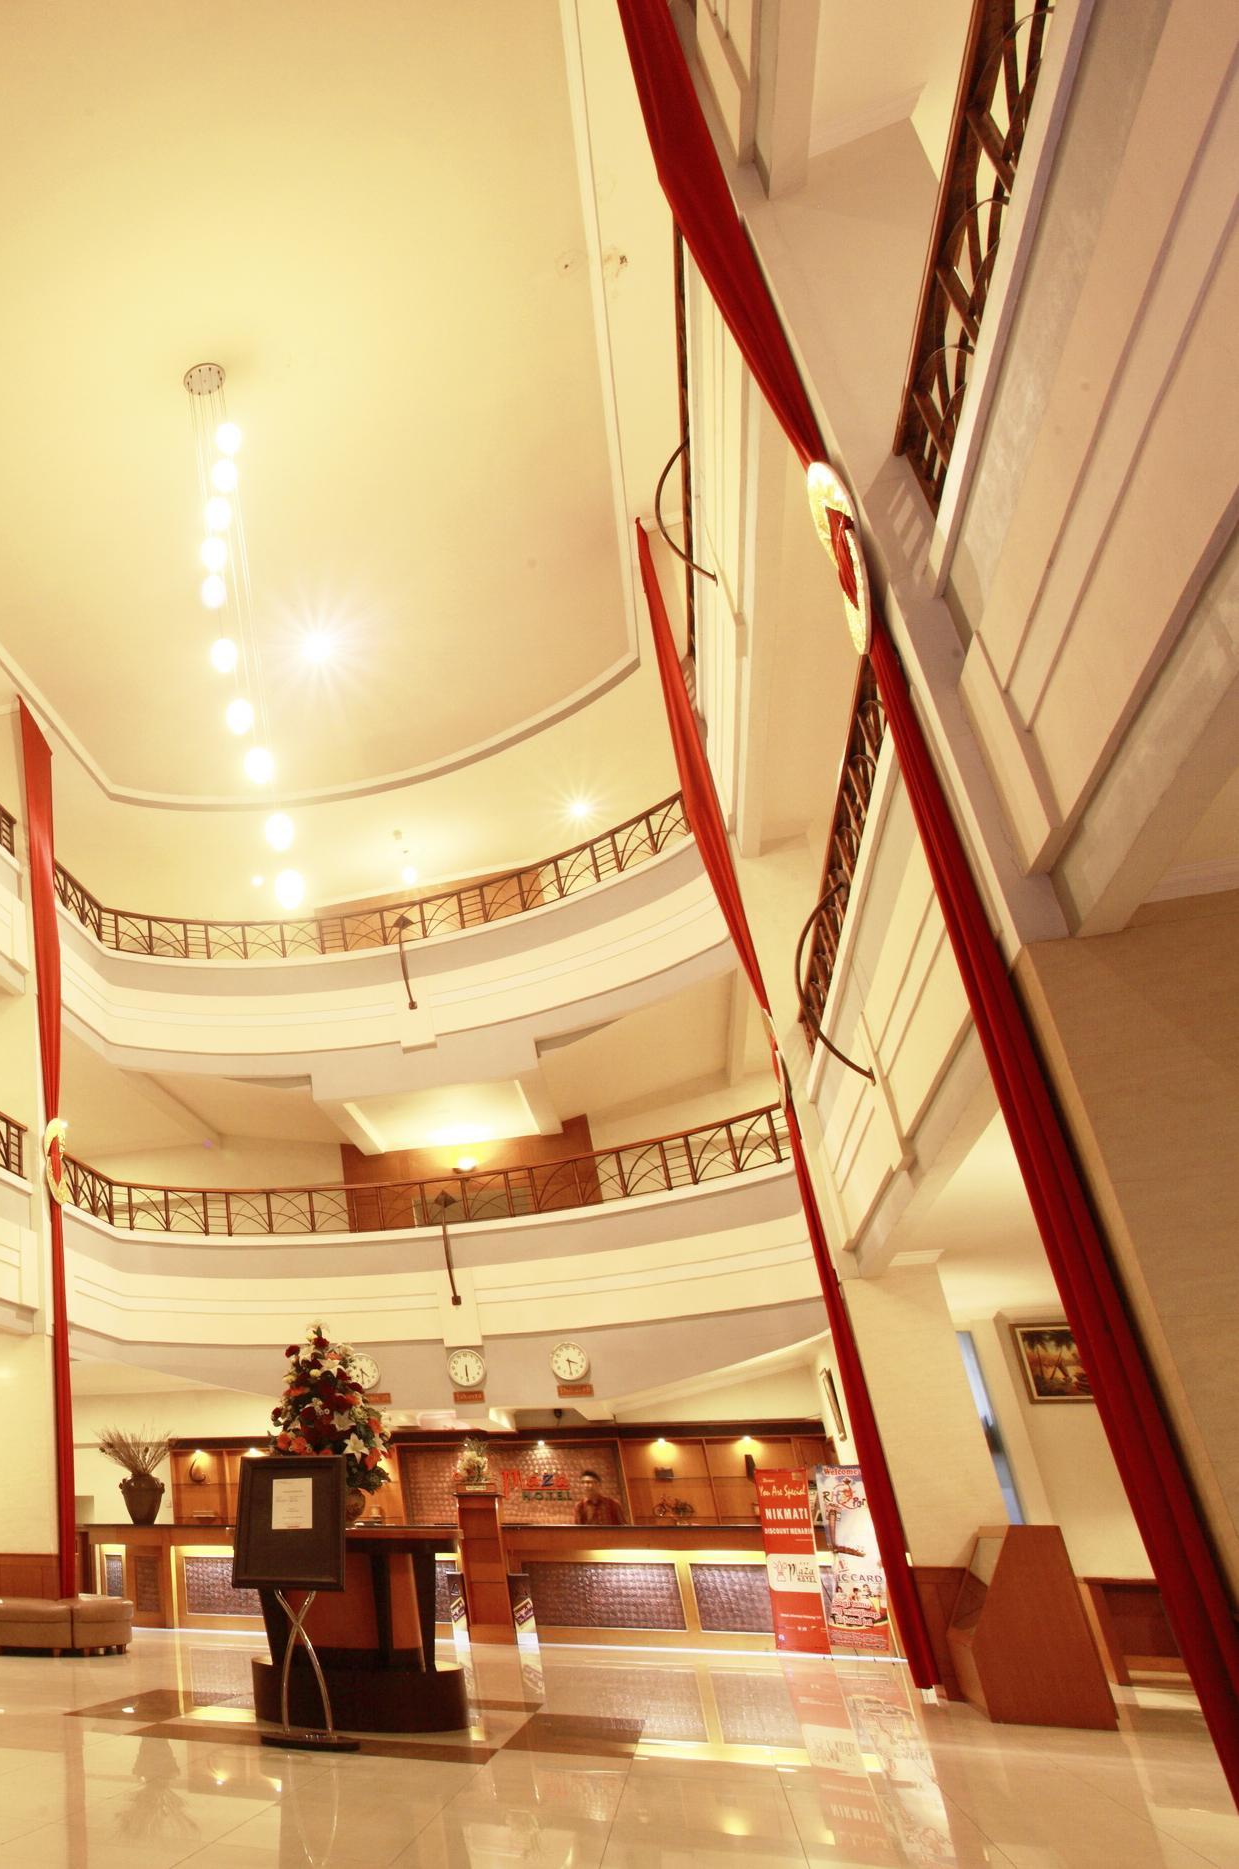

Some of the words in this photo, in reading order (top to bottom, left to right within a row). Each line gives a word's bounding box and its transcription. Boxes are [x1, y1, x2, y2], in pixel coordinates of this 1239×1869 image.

[823, 1467, 858, 1476] Welcome
[758, 1485, 771, 1497] You
[771, 1485, 783, 1496] Are
[764, 1508, 809, 1520] NIKMATI
[851, 1574, 883, 1583] CARD
